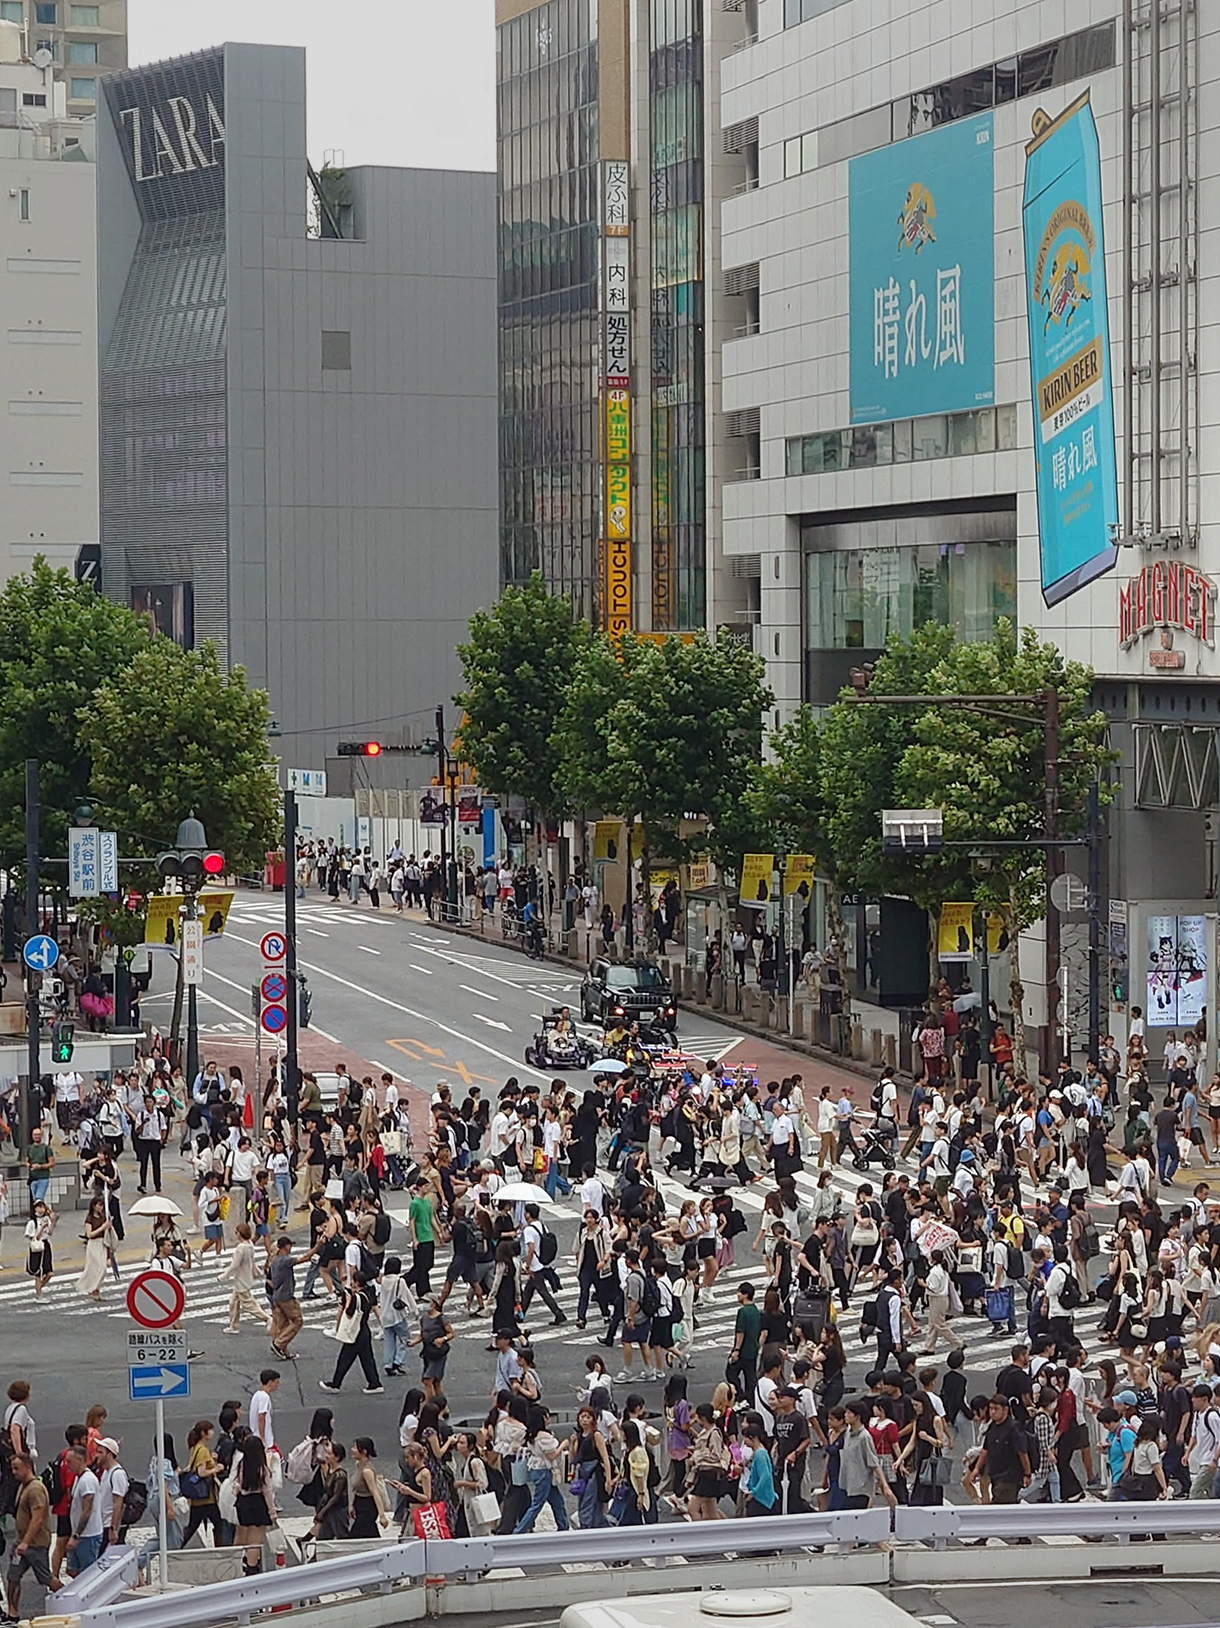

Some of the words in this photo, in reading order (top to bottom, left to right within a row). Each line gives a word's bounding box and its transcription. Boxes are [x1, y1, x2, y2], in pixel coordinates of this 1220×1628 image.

[119, 92, 225, 181] ZARA
[606, 162, 627, 224] 皮ふ科
[610, 226, 624, 235] 7F
[608, 263, 627, 306] 内科
[607, 316, 628, 374] 処方せん
[874, 263, 965, 379] 晴れ風
[611, 390, 624, 401] 4F
[1042, 368, 1072, 412] KIRIN
[1072, 349, 1098, 389] BEER
[1051, 424, 1098, 492] 晴れ風
[612, 540, 627, 612] TOUCH
[1119, 562, 1213, 646] MAGNET
[81, 833, 95, 891] 渋谷駅前
[102, 834, 114, 890] スクランブル式
[137, 1348, 176, 1361] 6-22
